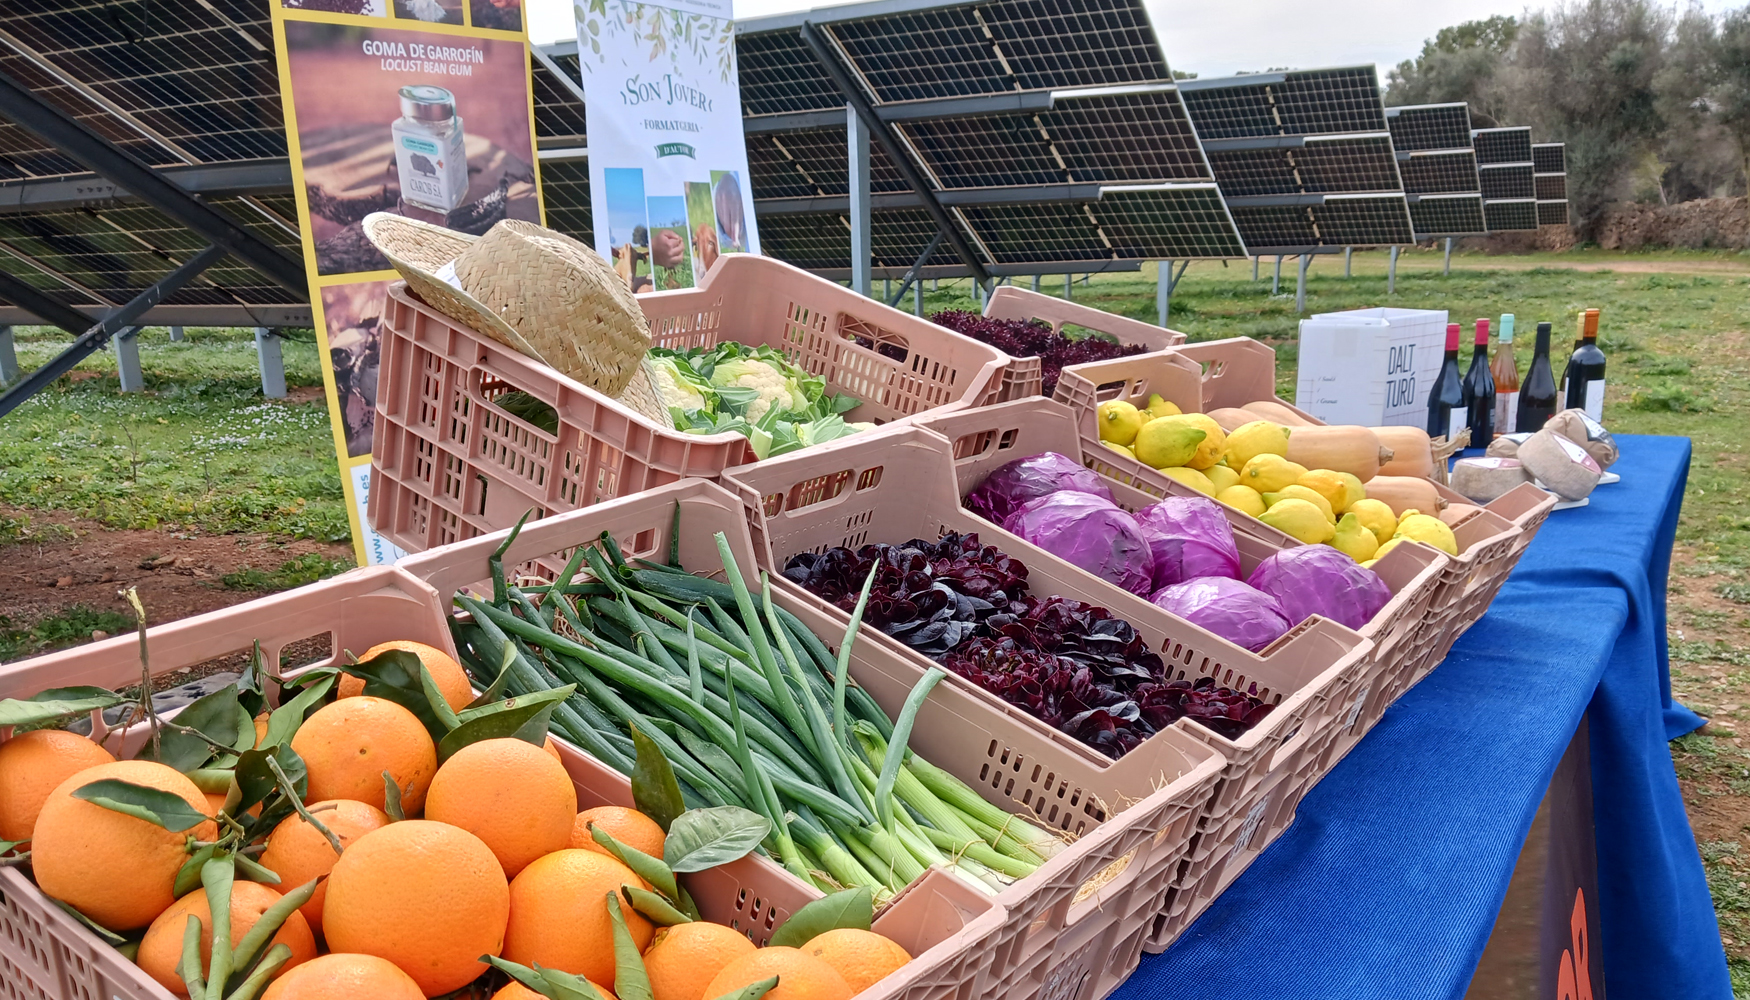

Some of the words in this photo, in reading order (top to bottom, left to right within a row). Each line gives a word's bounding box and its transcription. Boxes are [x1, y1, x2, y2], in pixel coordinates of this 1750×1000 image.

[362, 40, 407, 57] GOMA
[409, 43, 426, 59] DE
[427, 45, 484, 64] GARROFÍN
[381, 58, 422, 72] LOCUST
[424, 61, 447, 75] BEAN
[449, 63, 472, 76] GUM
[626, 75, 661, 105] SON
[663, 73, 707, 112] JOVER
[643, 119, 700, 133] FORMATGERIA
[1388, 344, 1416, 375] DALT
[1386, 371, 1416, 409] TURÓ
